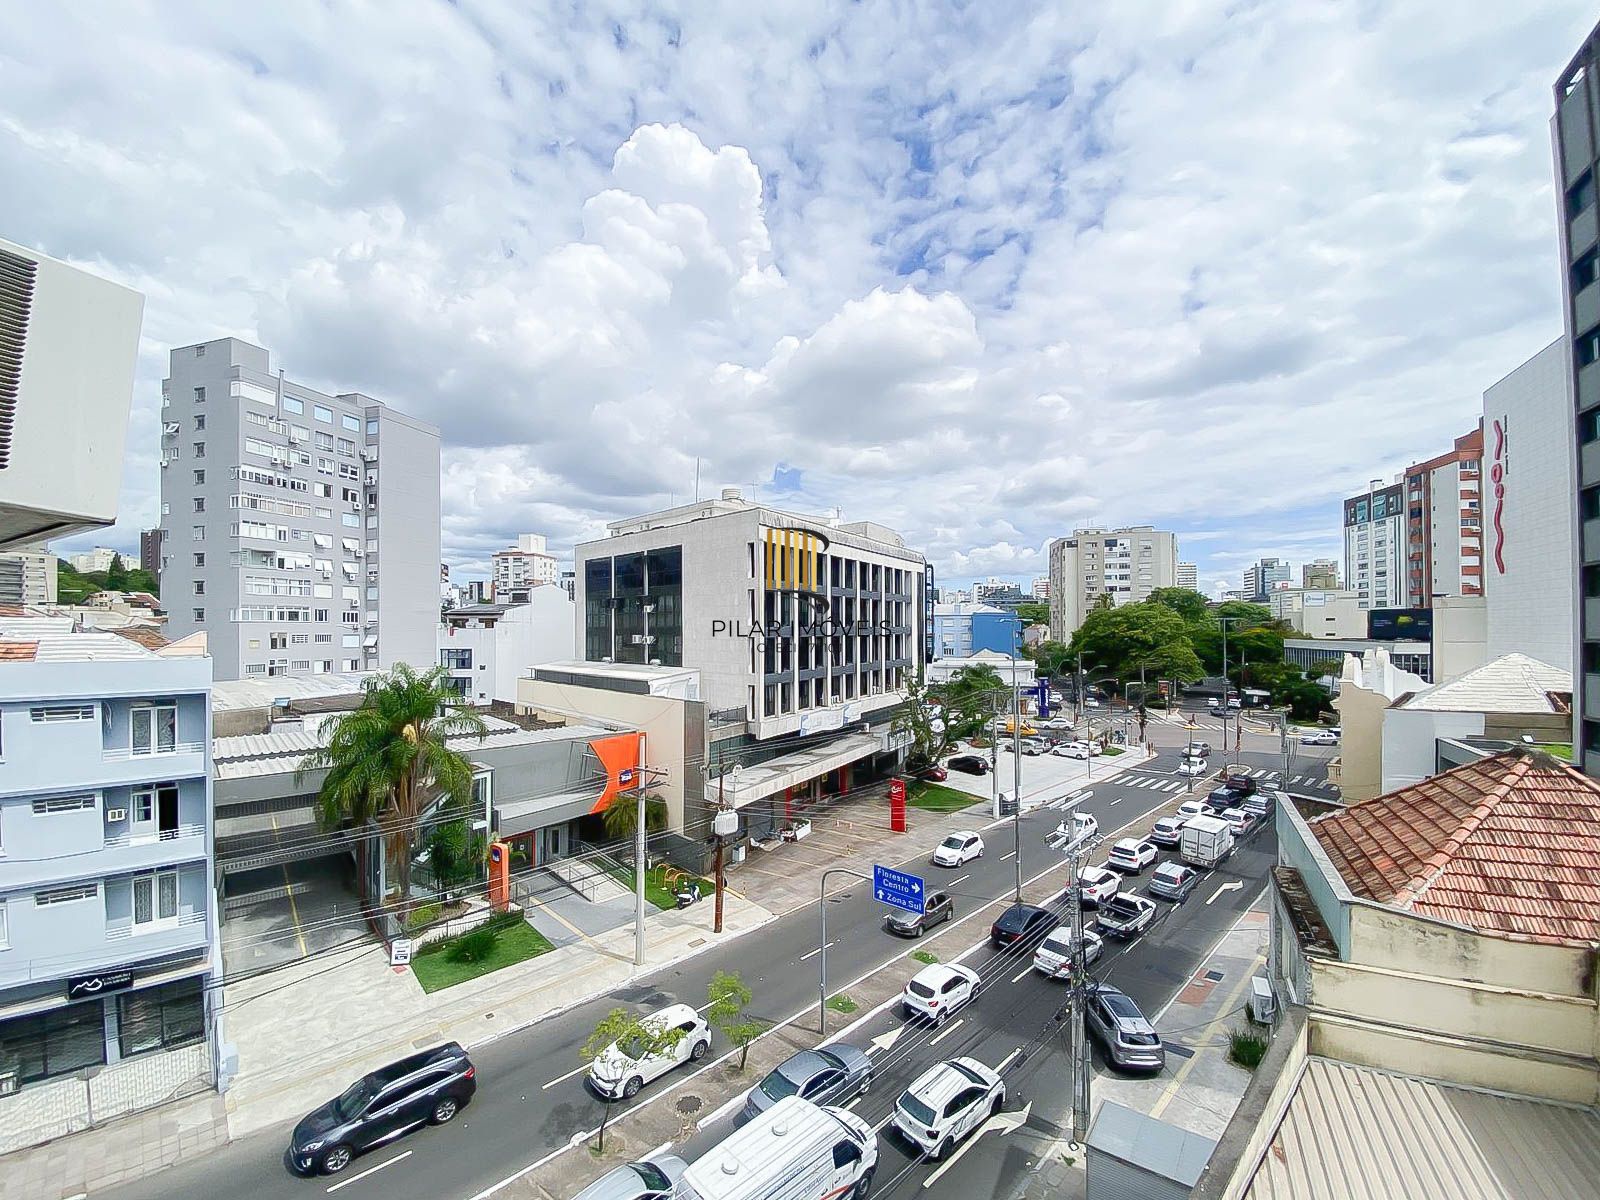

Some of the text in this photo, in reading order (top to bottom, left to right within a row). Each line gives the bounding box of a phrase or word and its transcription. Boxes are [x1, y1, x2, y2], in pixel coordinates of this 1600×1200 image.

[877, 867, 909, 884] Floresta
[882, 879, 909, 893] Centro
[886, 893, 922, 911] Zona Sul
